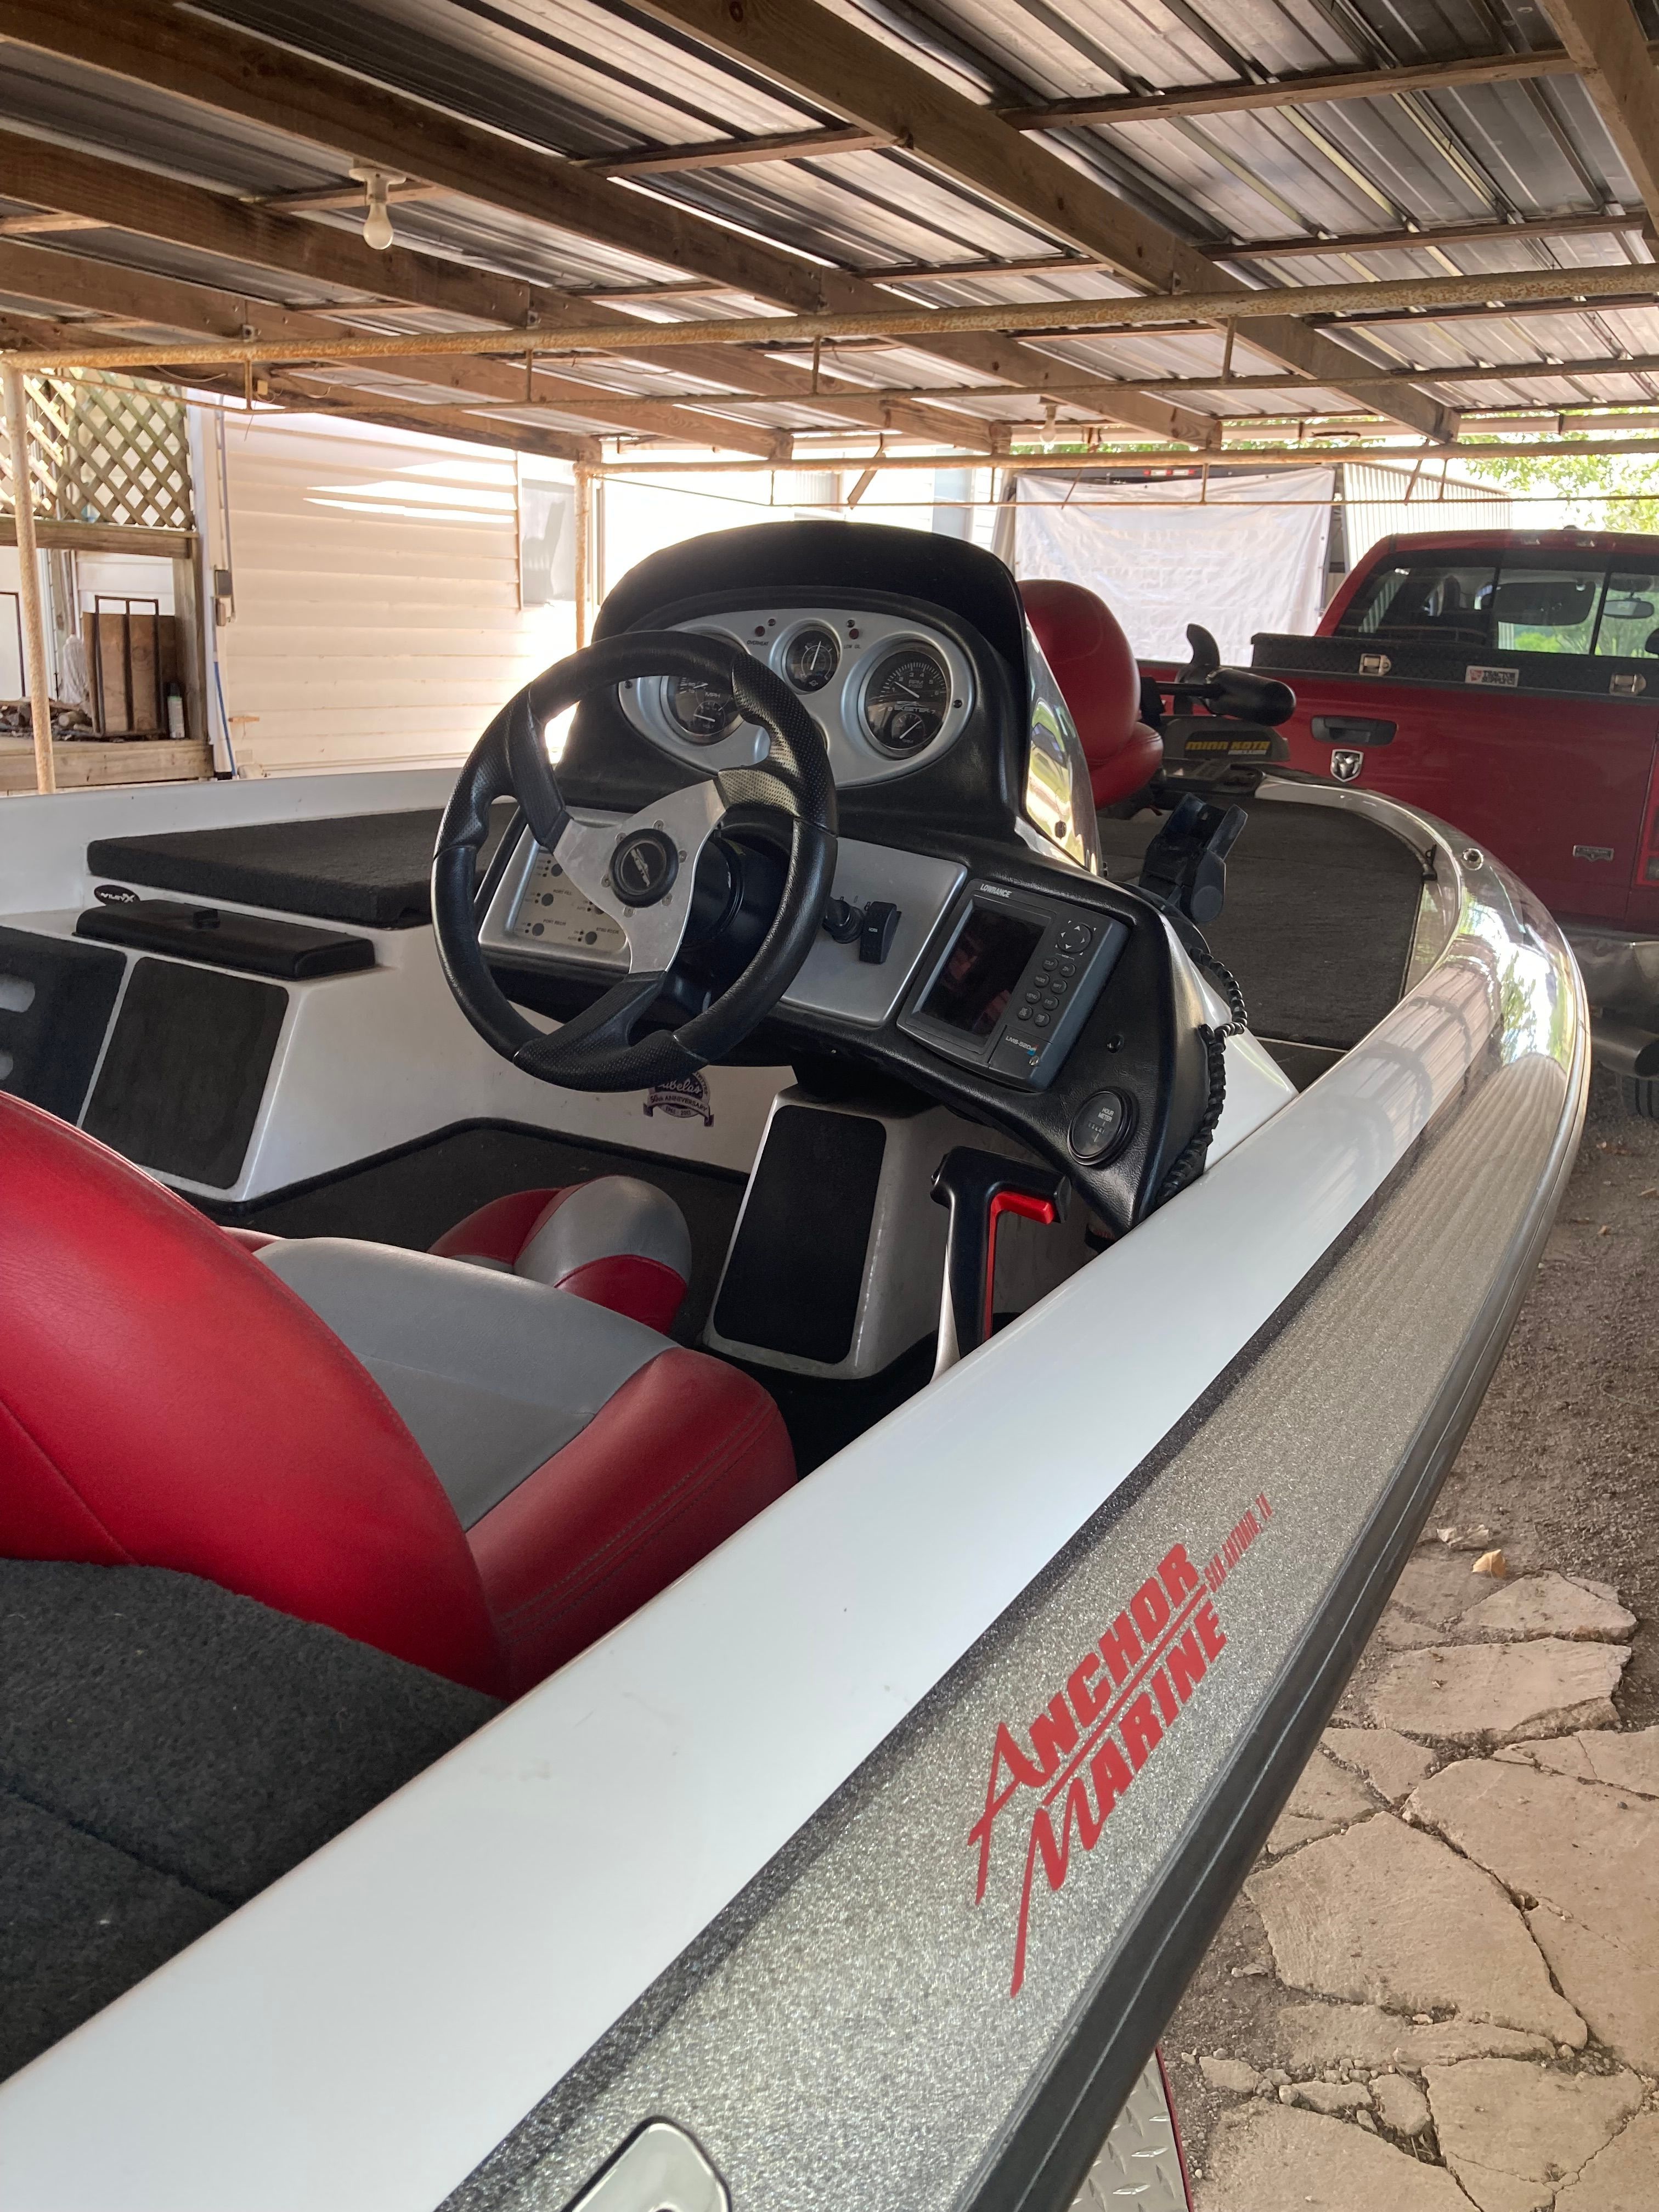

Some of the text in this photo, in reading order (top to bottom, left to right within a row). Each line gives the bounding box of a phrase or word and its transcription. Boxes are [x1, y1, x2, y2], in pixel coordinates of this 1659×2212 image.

[980, 883, 1012, 898] LOWRANCE
[664, 1095, 708, 1112] ANNIVERSARY
[1102, 1107, 1115, 1117] HOUR
[1098, 1111, 1113, 1122] METER
[1204, 1553, 1227, 1593] SAN
[968, 1543, 1200, 1905] ANCHOR
[1012, 1600, 1228, 1999] MARINE
